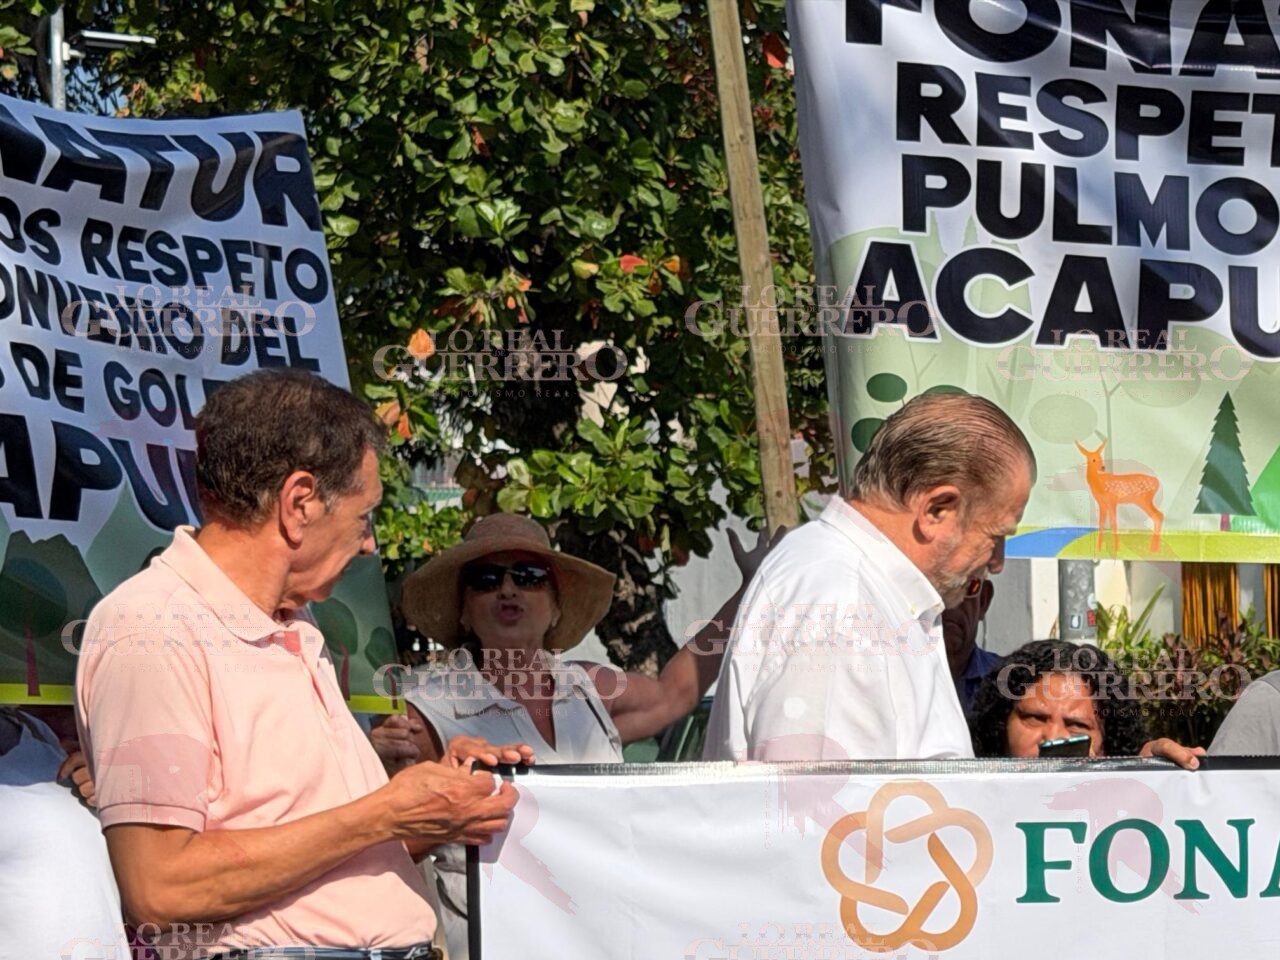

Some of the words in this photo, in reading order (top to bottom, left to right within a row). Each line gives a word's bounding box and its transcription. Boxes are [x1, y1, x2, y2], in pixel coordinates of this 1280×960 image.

[81, 217, 329, 305] RESPETO
[220, 306, 321, 373] DEL
[10, 341, 84, 413] DE
